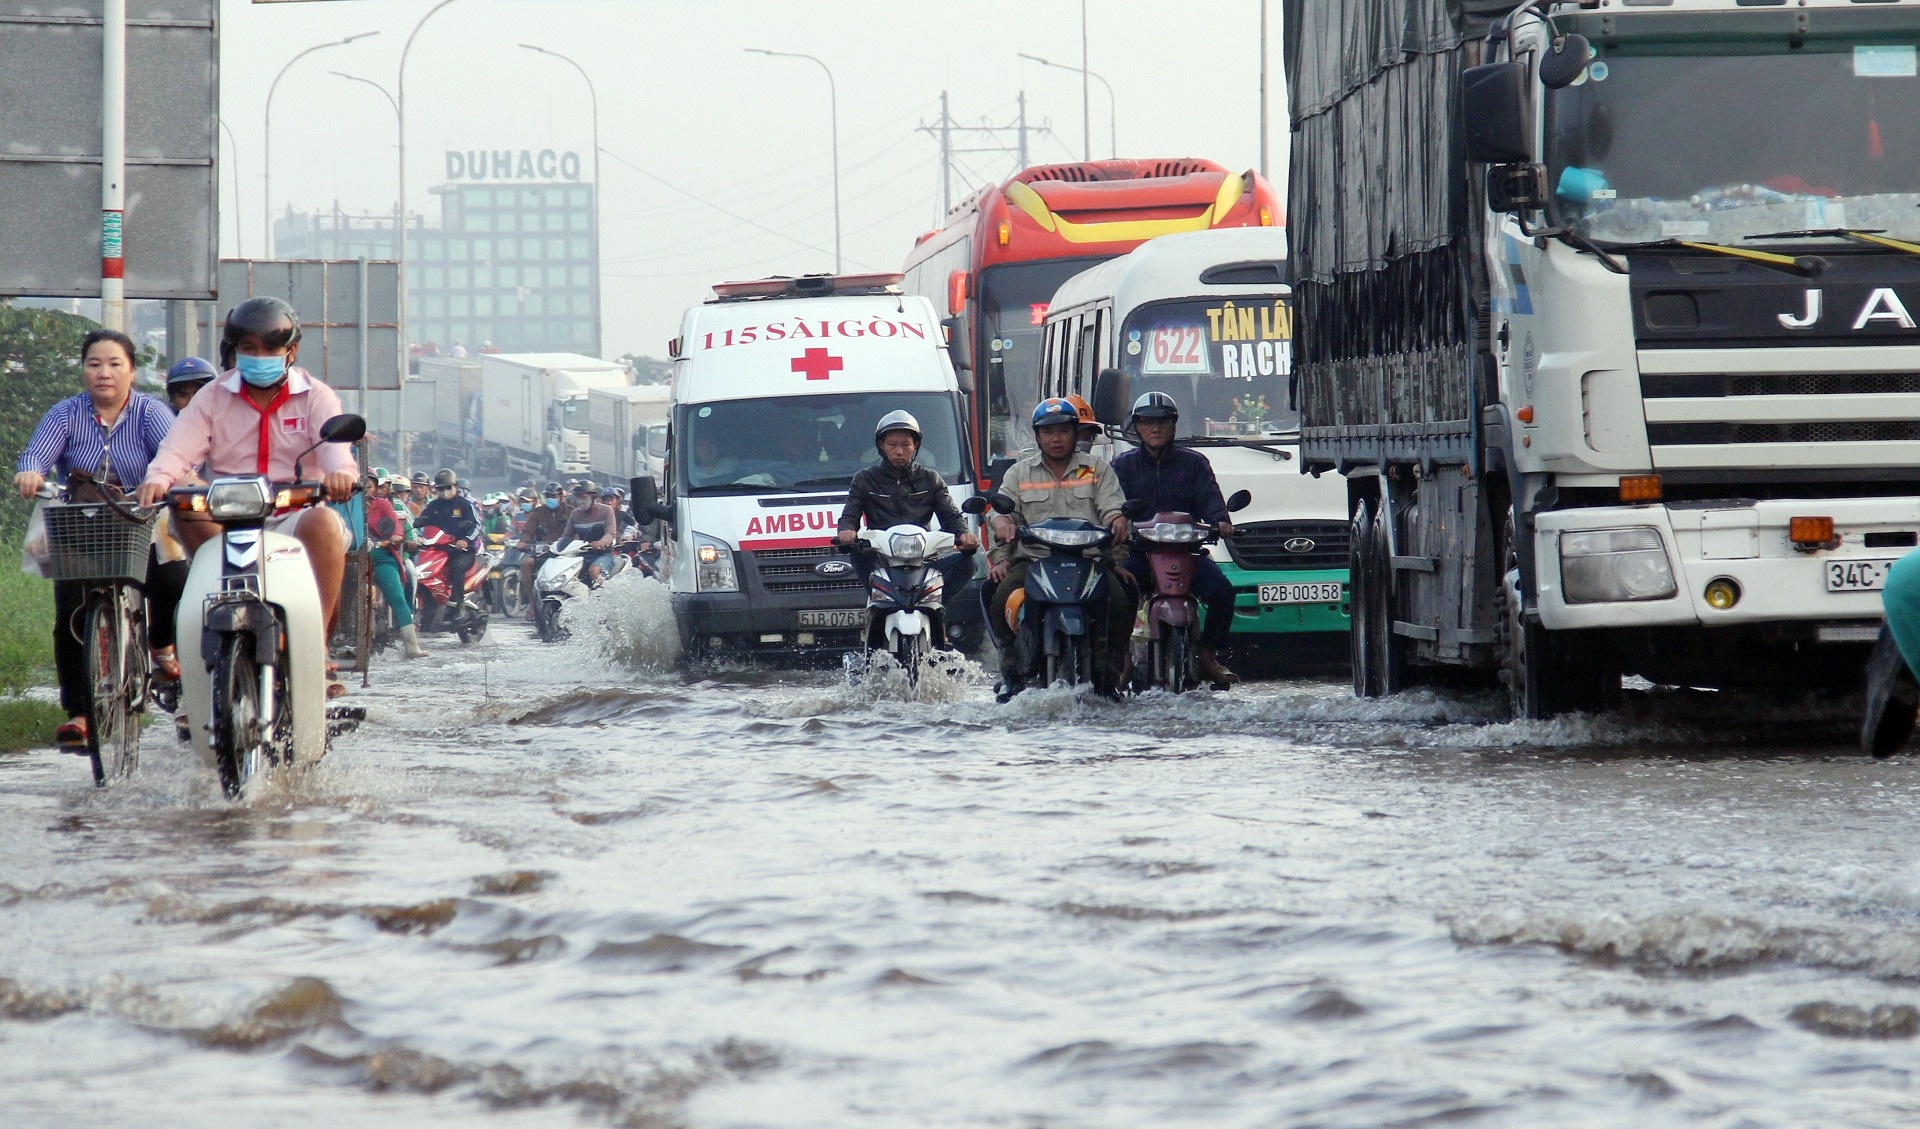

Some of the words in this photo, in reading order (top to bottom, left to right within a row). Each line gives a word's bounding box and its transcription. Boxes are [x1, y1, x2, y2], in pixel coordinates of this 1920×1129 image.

[445, 148, 581, 181] DUHACO
[701, 326, 758, 351] 115
[765, 315, 925, 341] SÀIGÒN
[1206, 300, 1256, 342] TÂN
[1260, 299, 1293, 341] LÂ
[1153, 325, 1200, 364] 622
[1222, 341, 1291, 382] RẠCH
[745, 511, 868, 536] AMBUL
[823, 563, 845, 573] Ford
